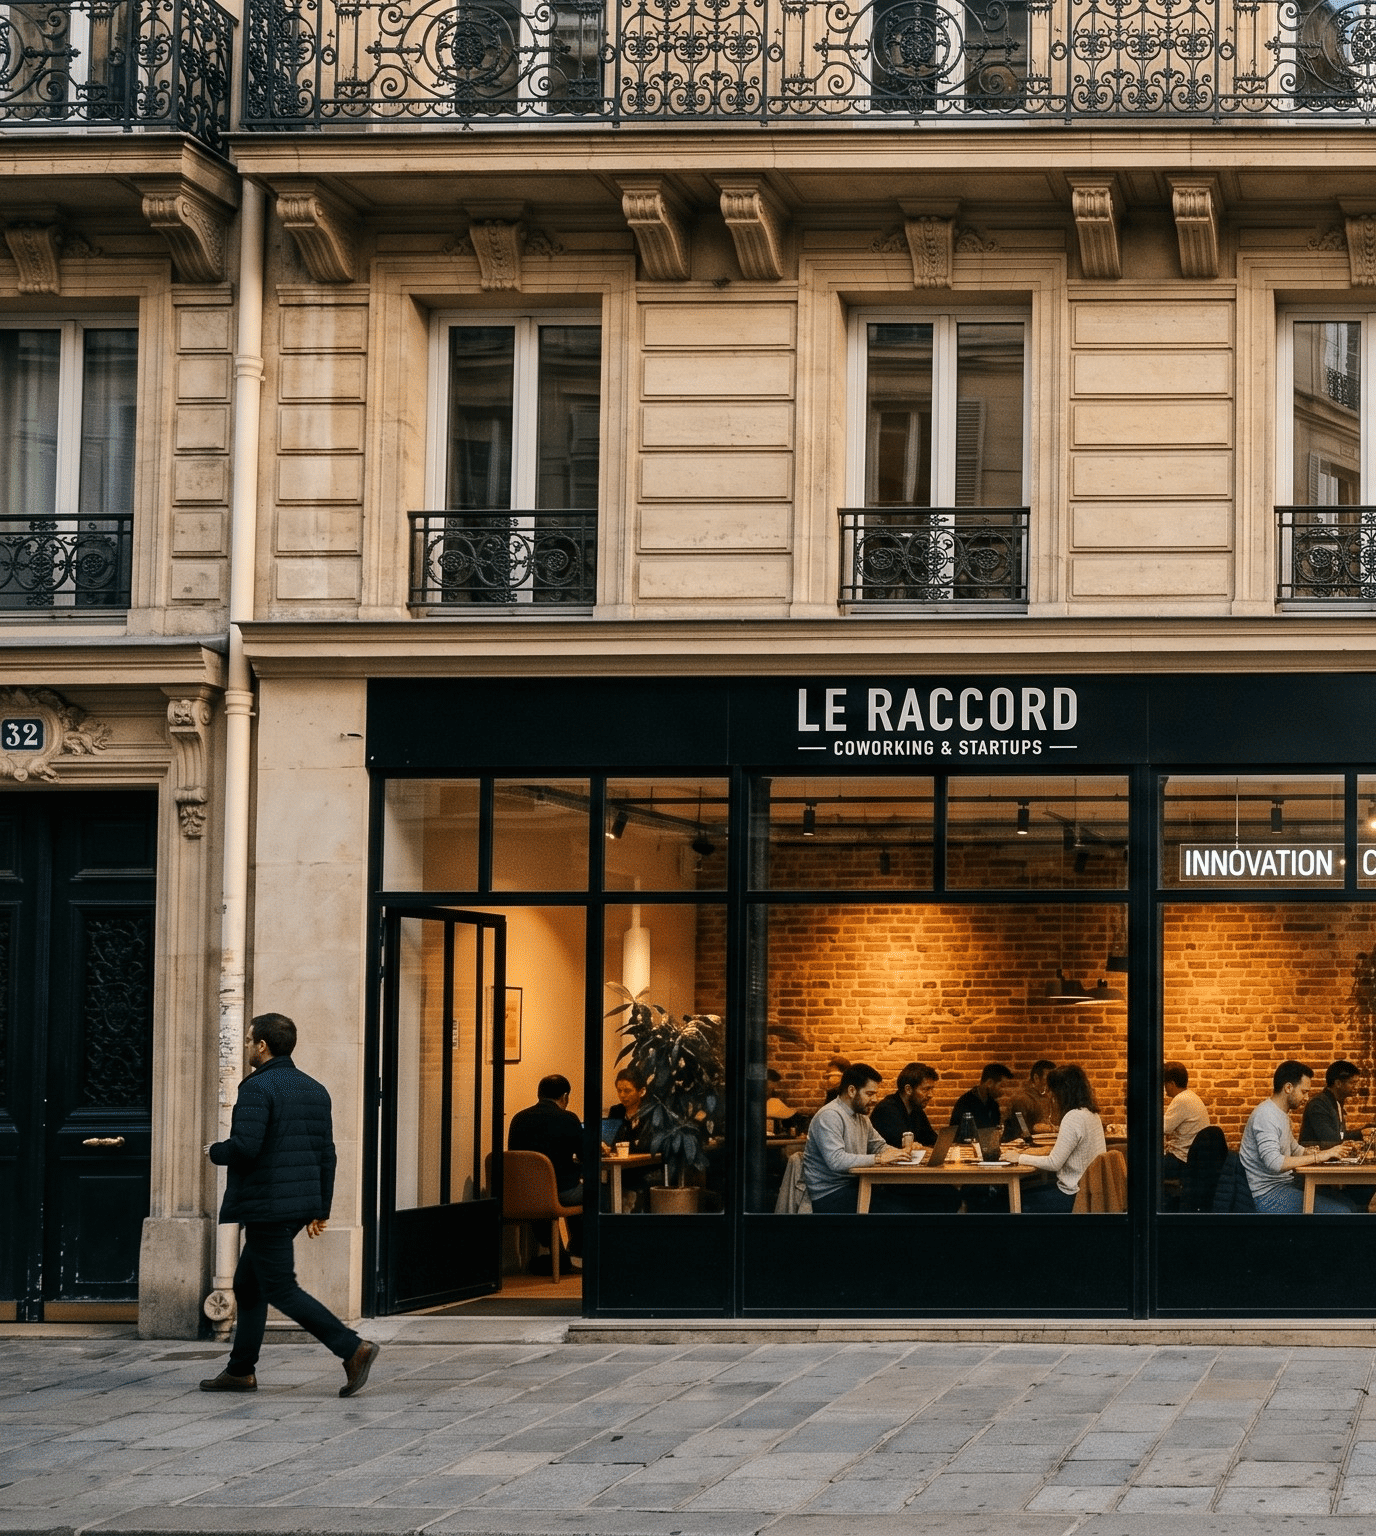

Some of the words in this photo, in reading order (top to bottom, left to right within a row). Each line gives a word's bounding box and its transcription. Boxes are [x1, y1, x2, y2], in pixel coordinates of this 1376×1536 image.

[798, 688, 847, 731] LE
[868, 687, 1078, 732] RACCORD
[6, 722, 38, 747] 32
[834, 740, 934, 756] COWORKING
[940, 740, 953, 755] &
[958, 739, 1043, 755] STARTUPS
[1185, 849, 1333, 876] INNOVATION
